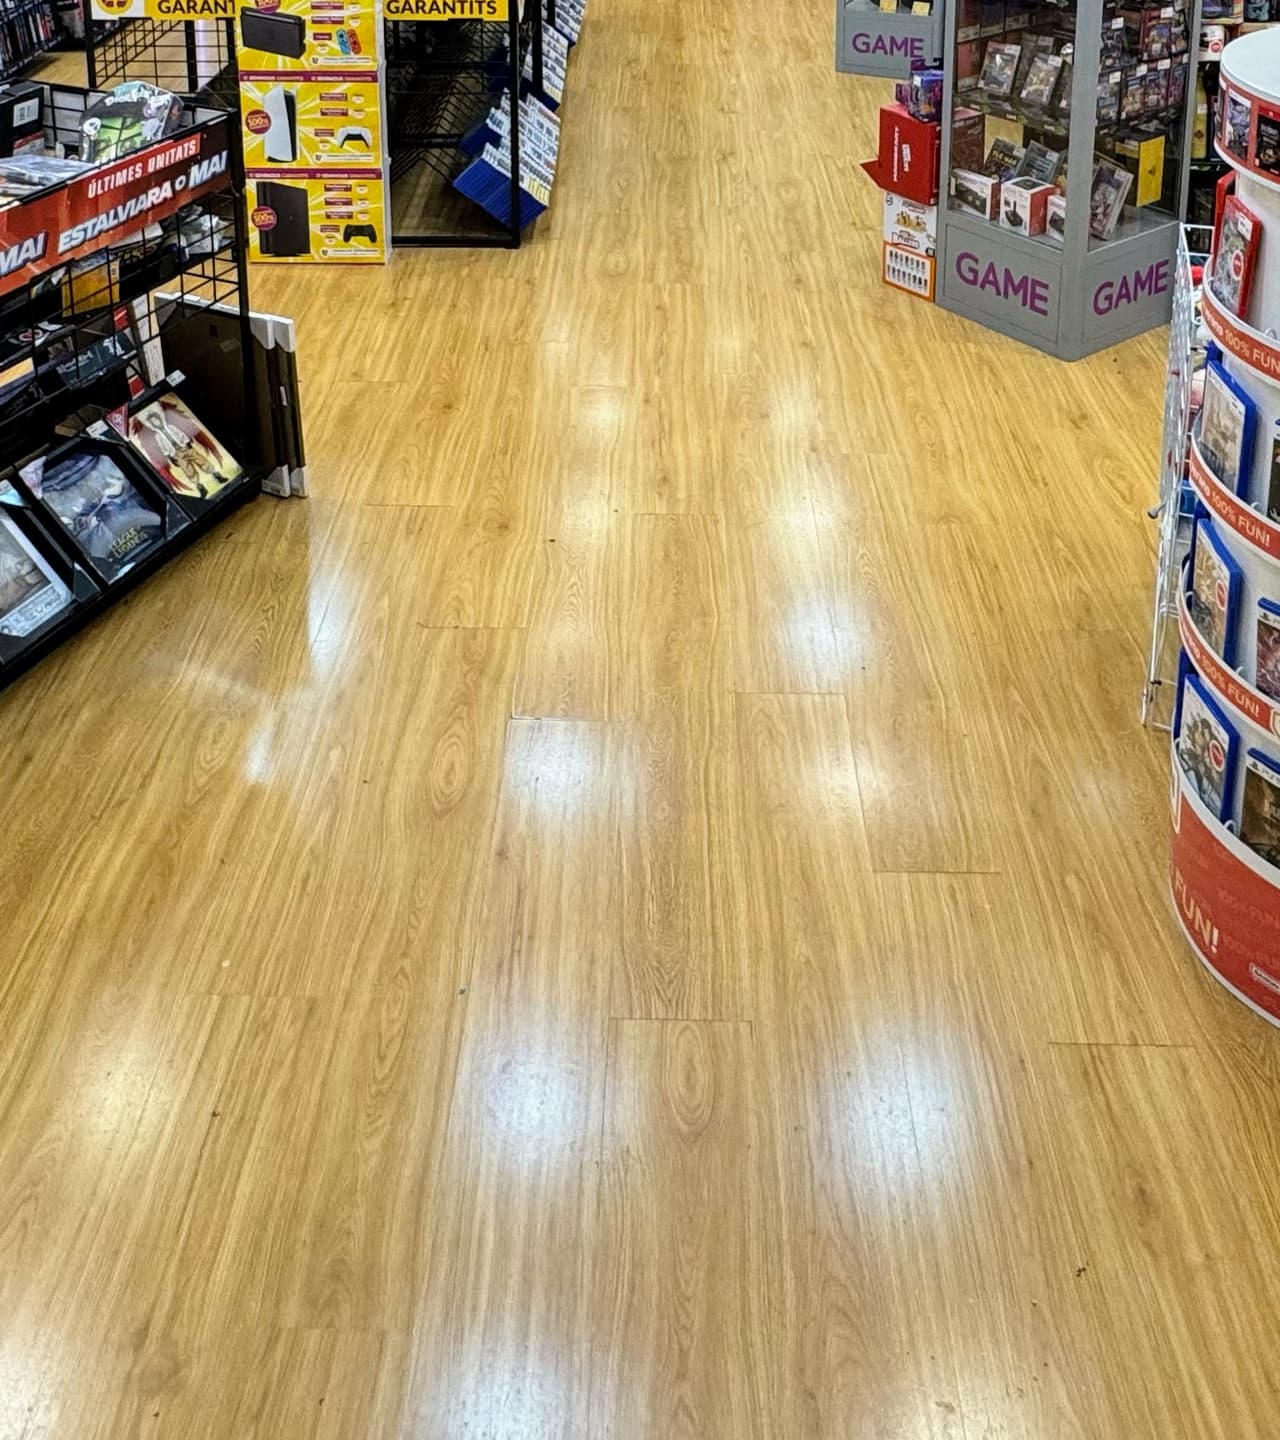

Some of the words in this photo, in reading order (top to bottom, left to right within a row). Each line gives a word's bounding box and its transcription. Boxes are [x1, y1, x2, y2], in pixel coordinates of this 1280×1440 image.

[385, 0, 497, 15] GARANTITS
[852, 32, 925, 59] GAME
[88, 165, 142, 198] ÚLTIMES
[148, 141, 196, 173] UNITATS
[58, 181, 173, 254] ESTALVIARA
[189, 150, 228, 189] MAI
[955, 251, 1050, 316] GAME
[1092, 260, 1169, 315] GAME
[1224, 328, 1252, 360] 100%
